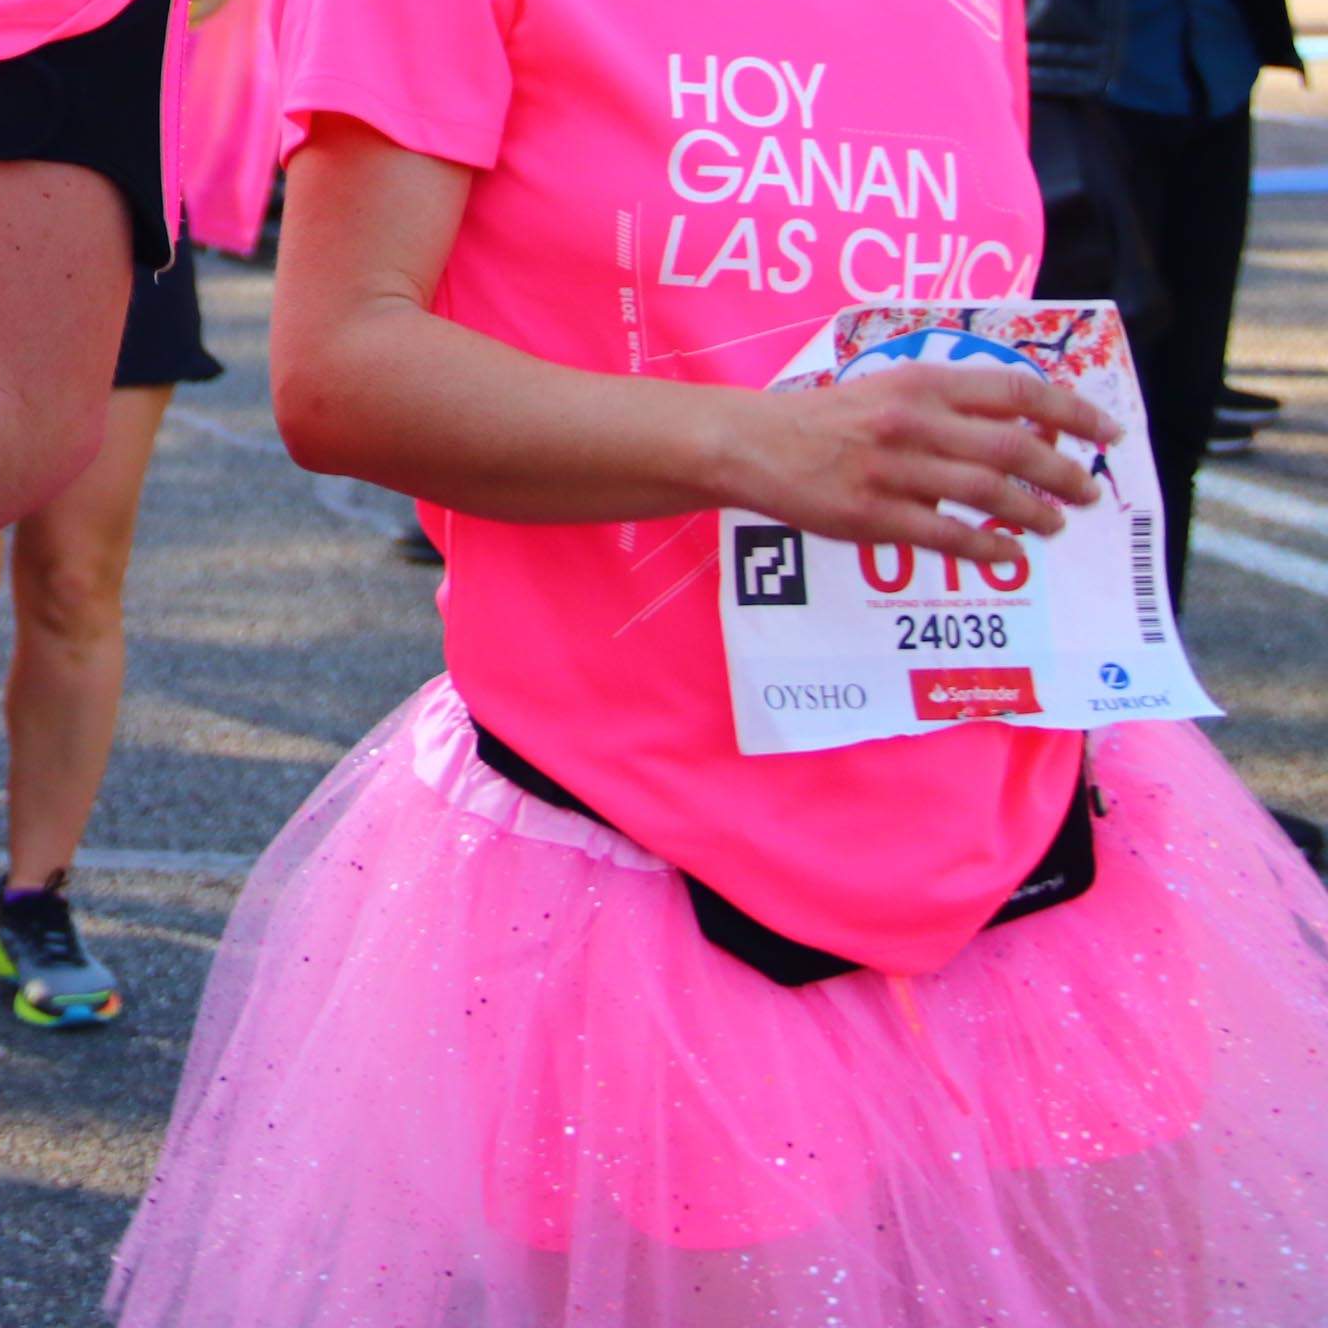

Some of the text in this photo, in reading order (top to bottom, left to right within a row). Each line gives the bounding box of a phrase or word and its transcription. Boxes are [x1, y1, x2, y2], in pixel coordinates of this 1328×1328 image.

[667, 52, 826, 128] HOY
[667, 129, 958, 221] GANAN
[657, 213, 1034, 304] LAS CHICA
[618, 286, 638, 324] 2018
[895, 613, 1009, 651] 24038
[763, 683, 868, 711] OYSHO
[947, 684, 1021, 704] Santander
[1088, 694, 1168, 713] ZURICH
